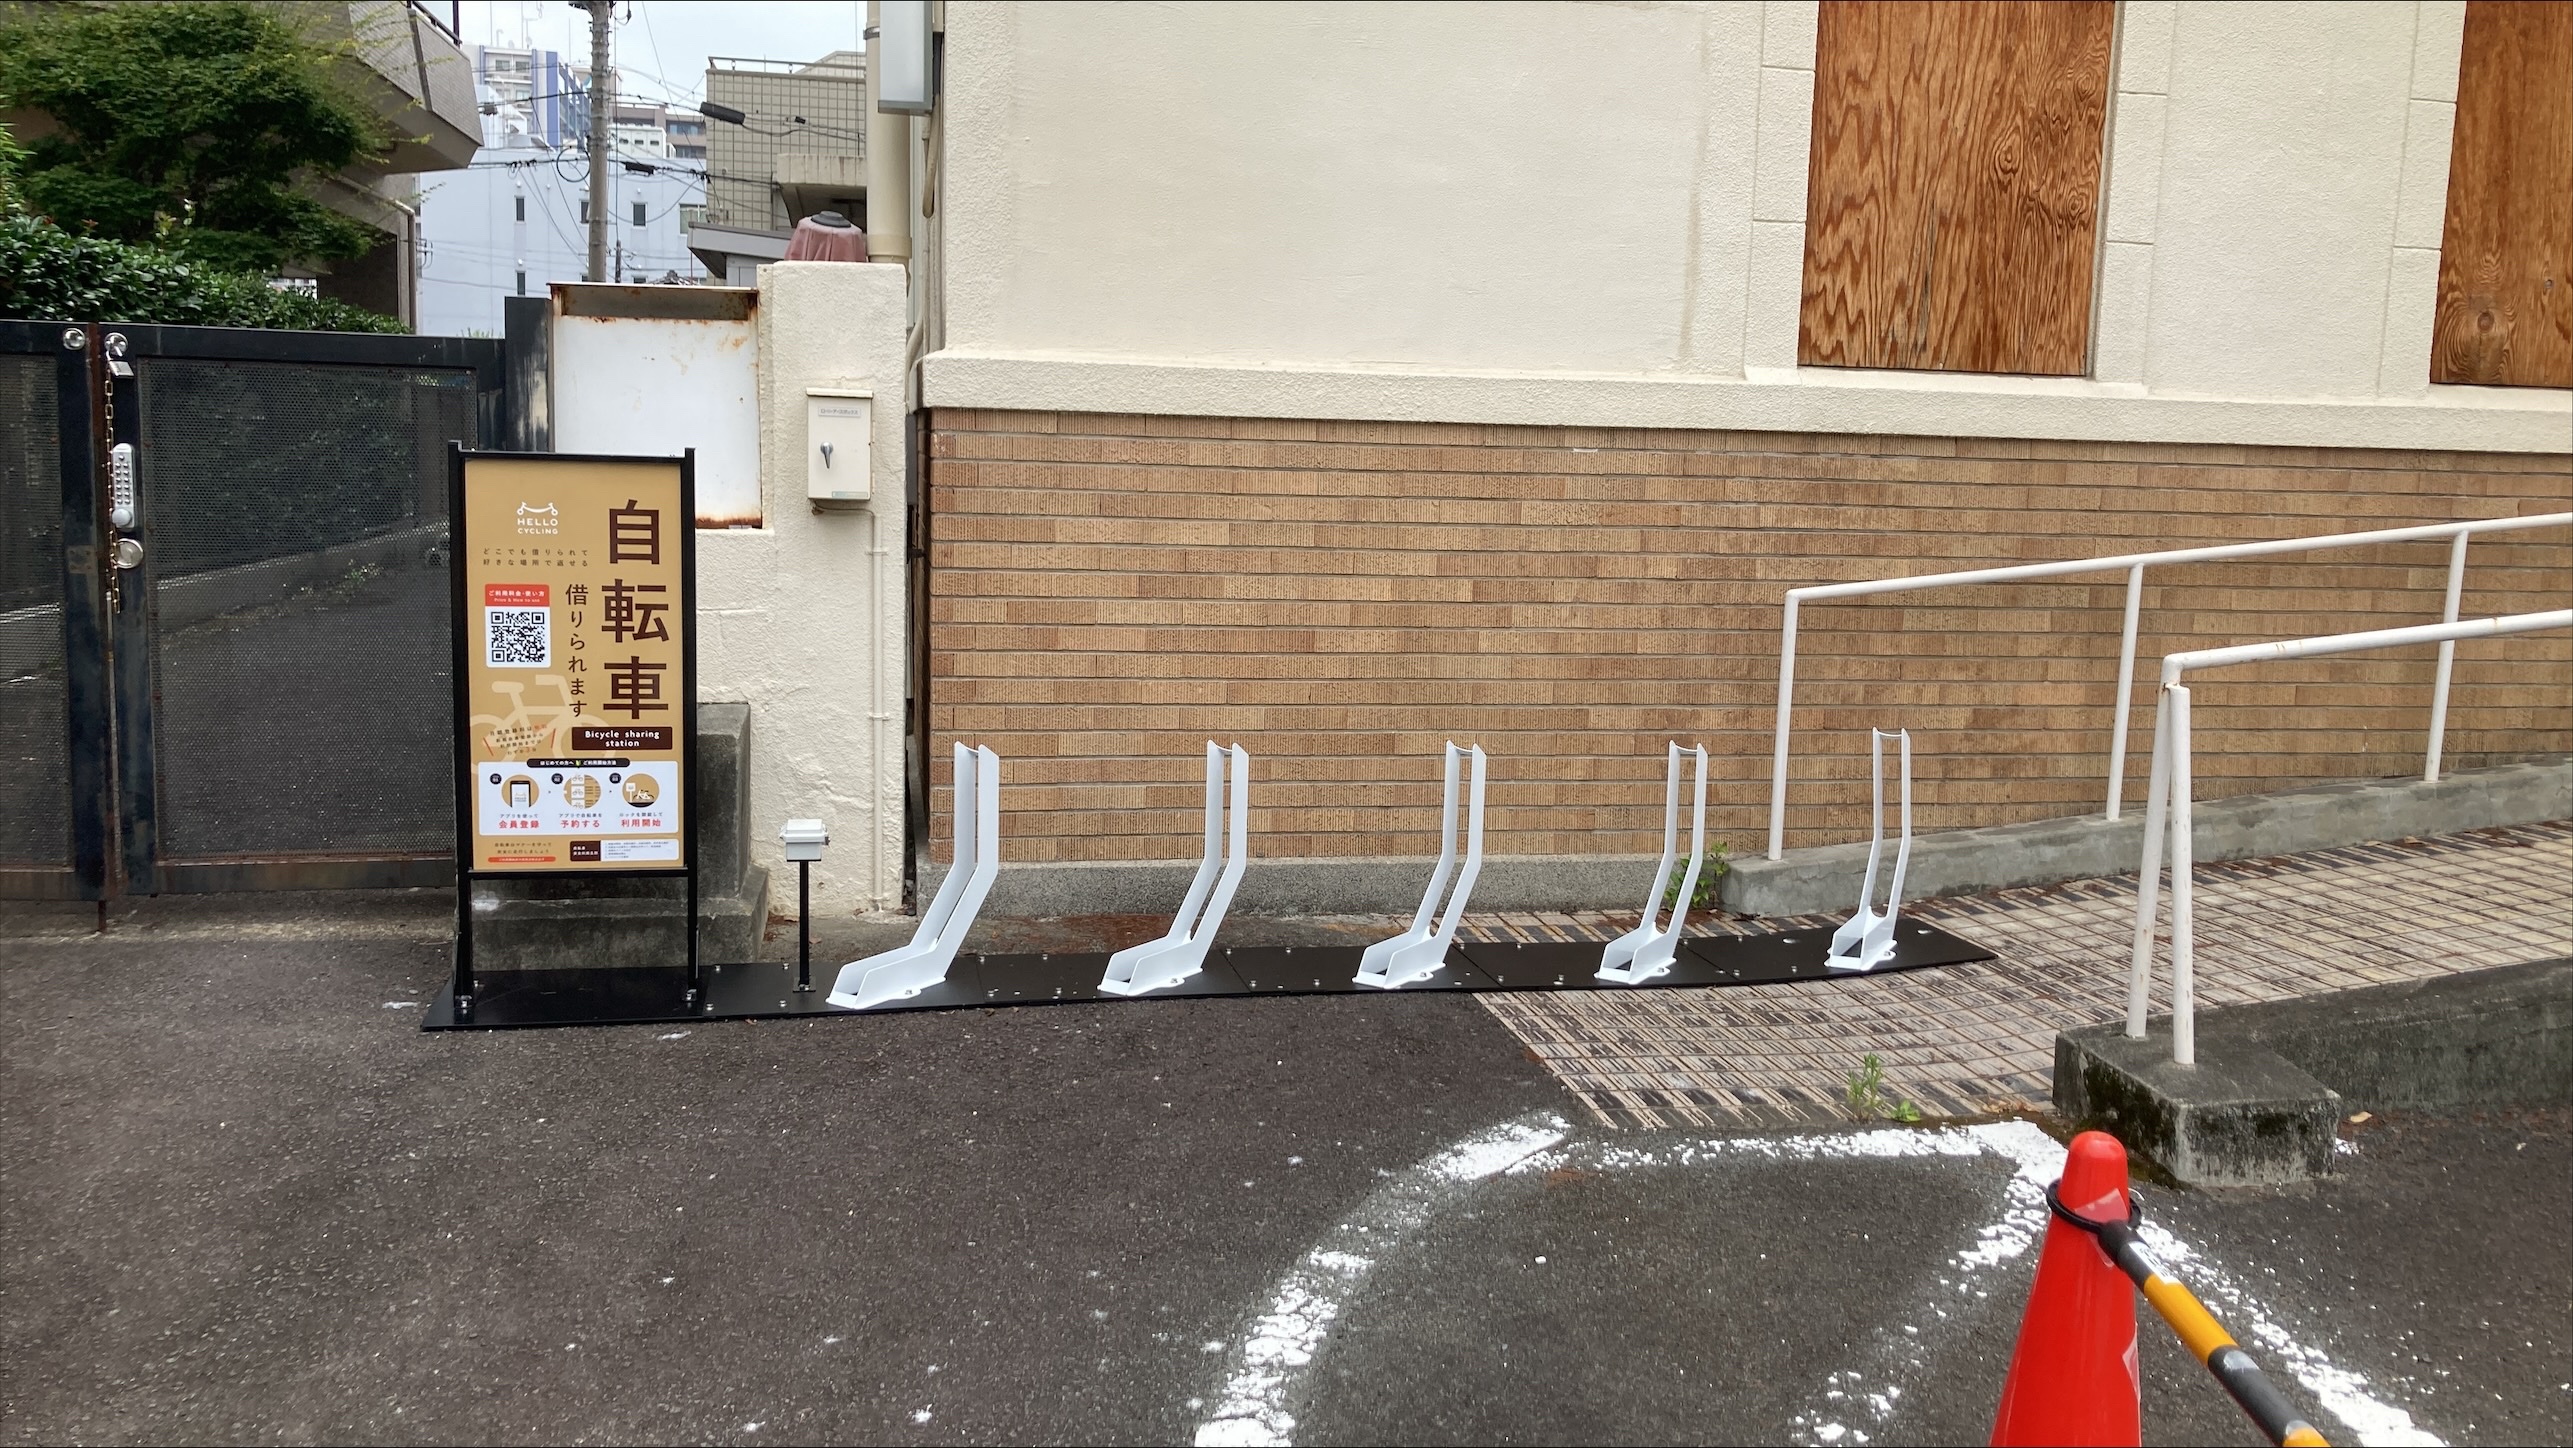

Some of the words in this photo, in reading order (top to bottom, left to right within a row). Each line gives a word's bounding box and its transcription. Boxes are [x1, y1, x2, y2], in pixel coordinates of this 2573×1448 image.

[517, 518, 559, 526] HELLO
[517, 527, 559, 535] CYCLING
[483, 548, 588, 556] どこでも借りられて
[483, 559, 588, 567] 好きな場所で返せる
[601, 499, 670, 720] 自転車
[565, 584, 589, 717] 借りられます
[584, 730, 620, 740] Bicycle
[624, 730, 660, 740] sharing
[605, 740, 640, 748] station
[499, 820, 539, 829] 会員登録
[561, 820, 600, 828] 予約する
[621, 819, 661, 827] 利用開始
